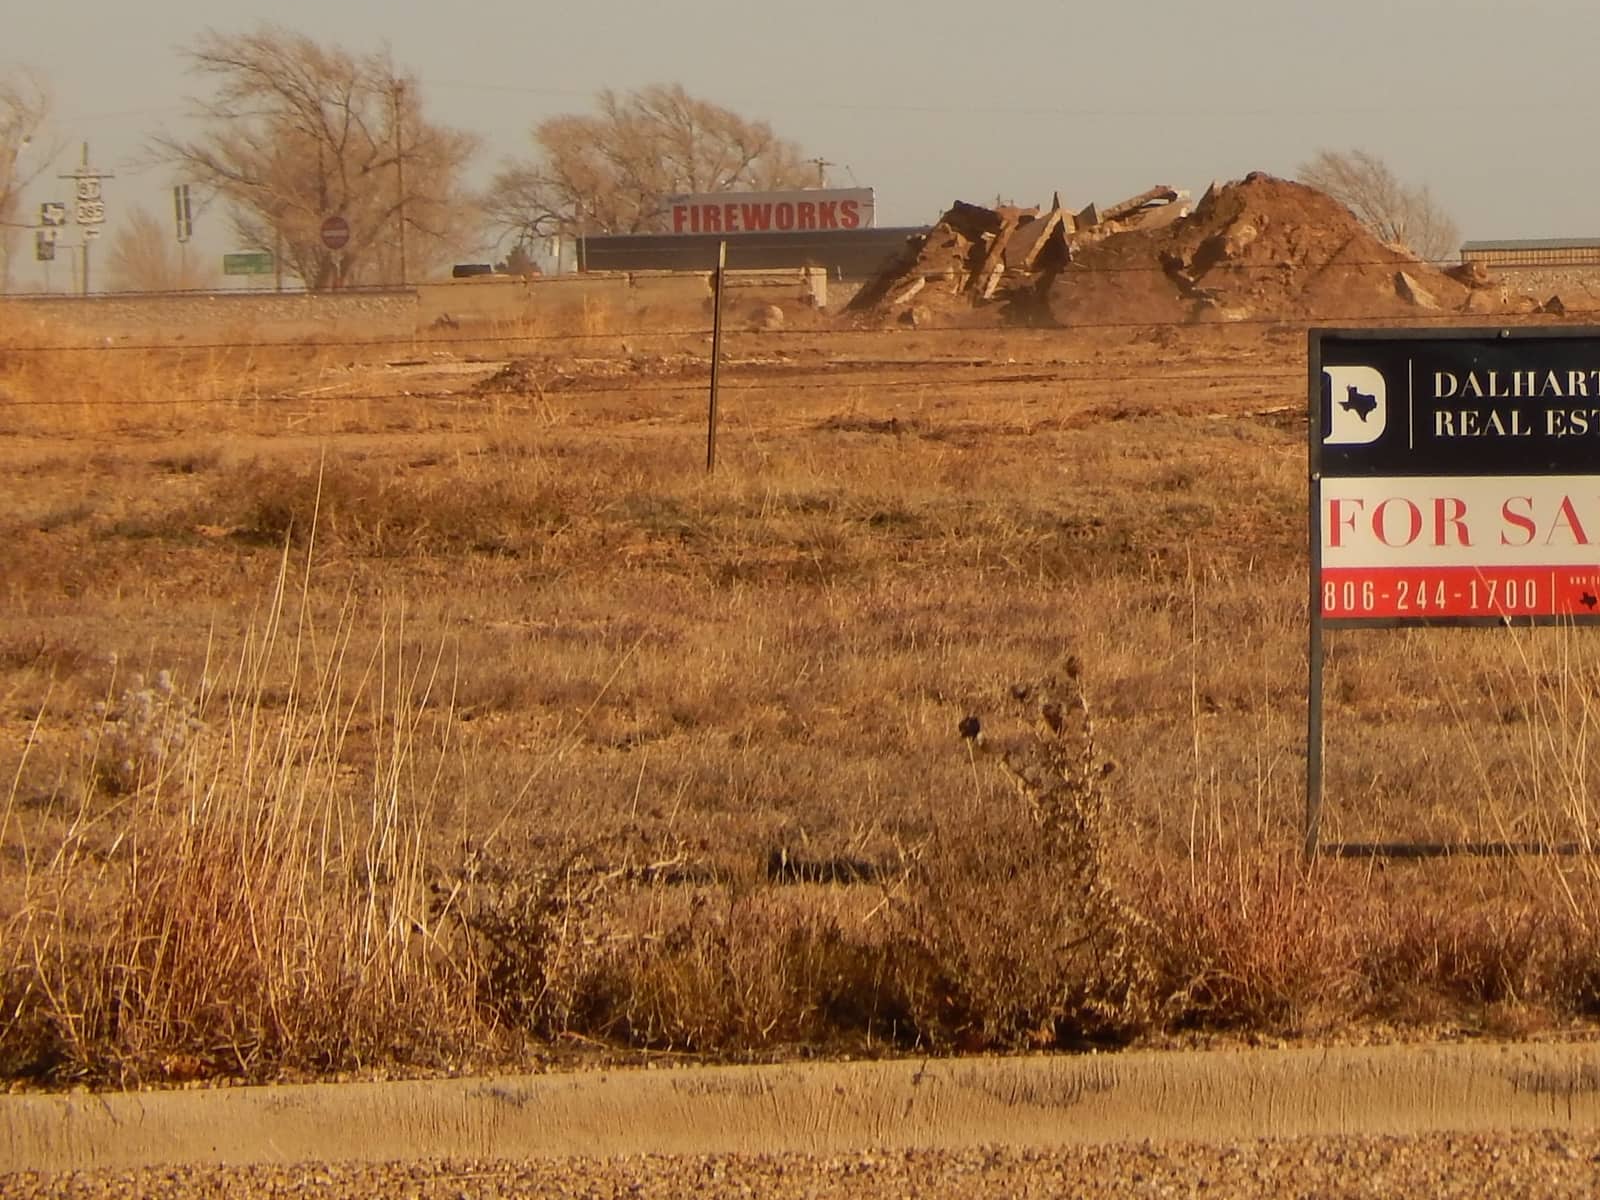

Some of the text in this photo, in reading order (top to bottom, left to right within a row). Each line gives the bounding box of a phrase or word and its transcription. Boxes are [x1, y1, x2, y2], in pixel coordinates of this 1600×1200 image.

[672, 200, 860, 233] FIREWORKS
[1434, 409, 1532, 437] REAL
[1325, 496, 1473, 548] FOR
[1324, 579, 1537, 611] 806-244-1700
